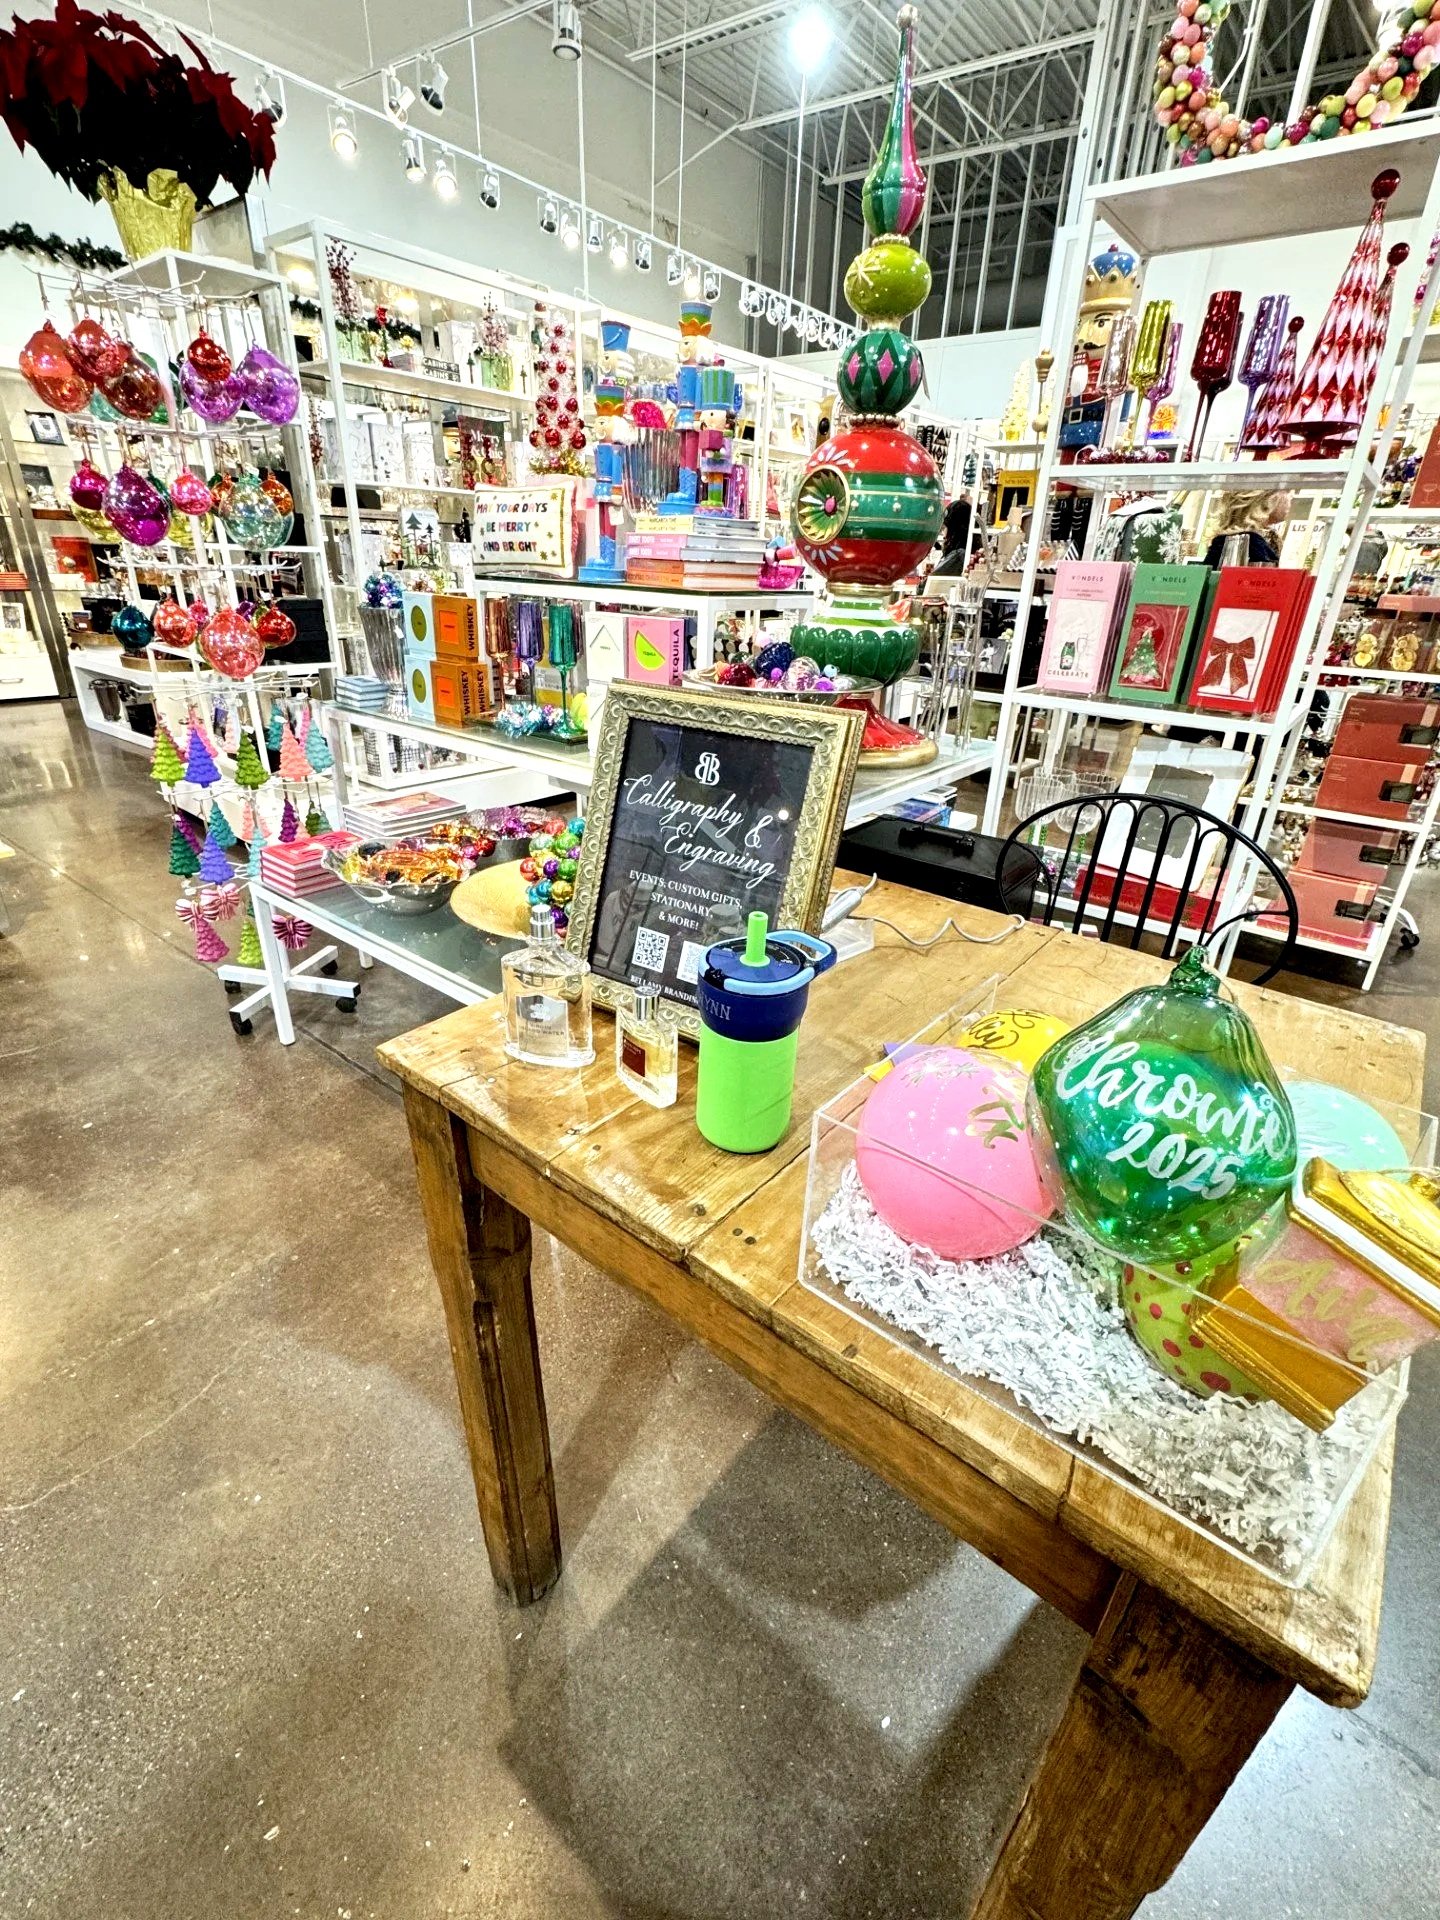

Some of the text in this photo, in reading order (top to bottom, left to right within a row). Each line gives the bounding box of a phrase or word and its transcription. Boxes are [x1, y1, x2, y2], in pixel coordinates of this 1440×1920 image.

[477, 502, 548, 514] MAY YOUR DAYS
[486, 522, 532, 533] BE MERRY
[483, 541, 537, 552] AND BRIGHT
[466, 603, 475, 651] WHISKEY
[672, 628, 680, 681] TEQUILA
[477, 669, 486, 713] WHISKEY
[1047, 669, 1089, 679] CELEBRATE
[461, 670, 471, 716] WHISKEY
[623, 774, 774, 849] Calligraphy &
[660, 821, 777, 889] Engraving
[650, 891, 714, 918] STATIONARY,
[667, 880, 711, 900] CUSTOM
[710, 891, 743, 909] GIFTS,
[658, 910, 700, 931] & MORE!
[1105, 1121, 1246, 1200] 2025
